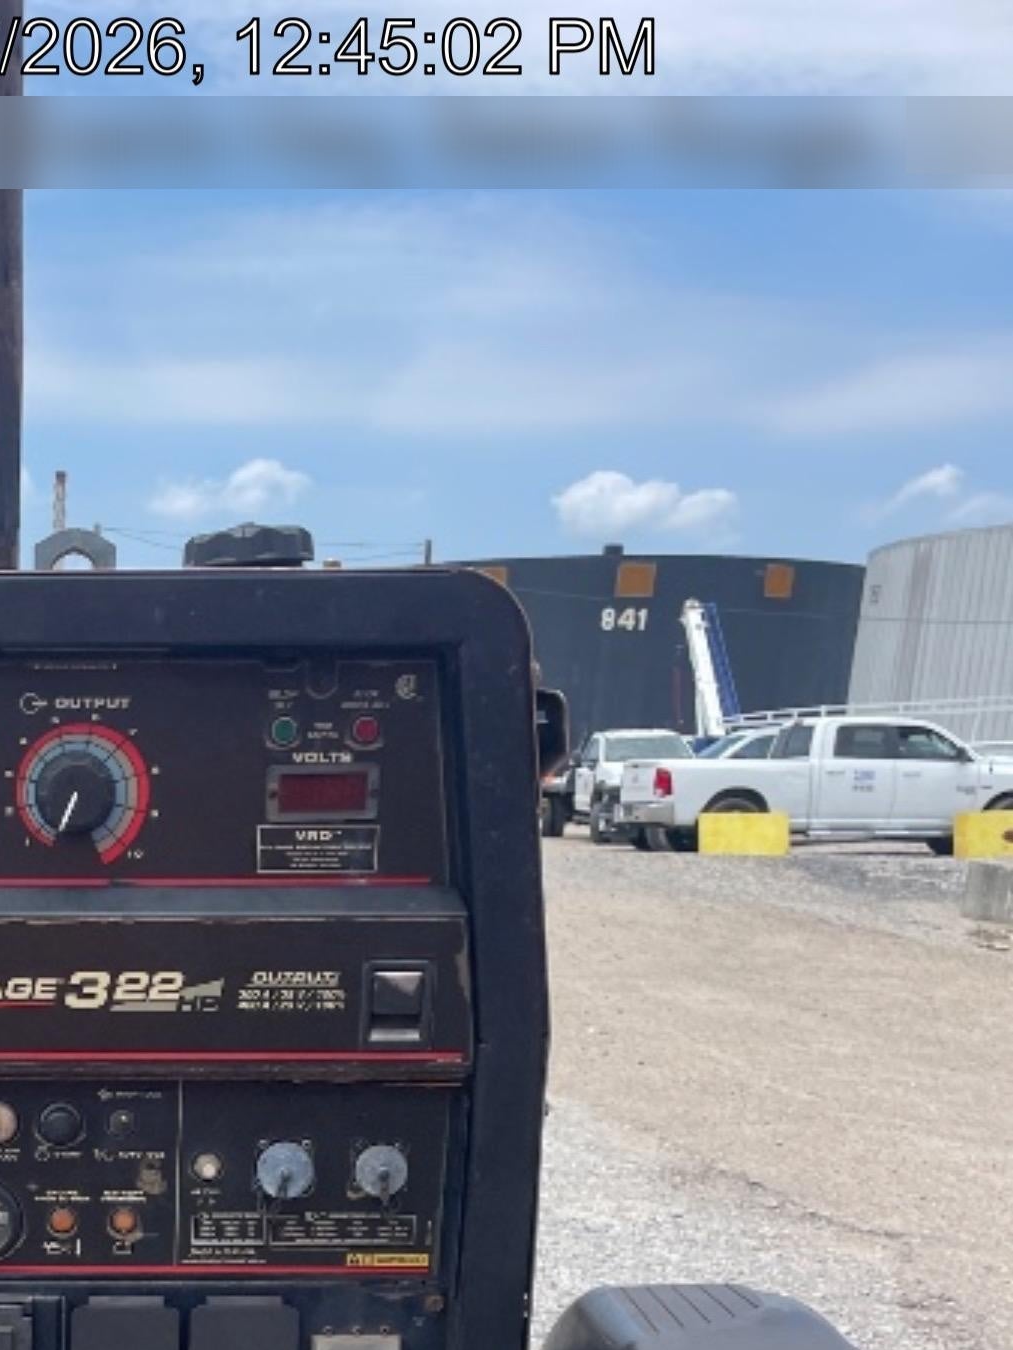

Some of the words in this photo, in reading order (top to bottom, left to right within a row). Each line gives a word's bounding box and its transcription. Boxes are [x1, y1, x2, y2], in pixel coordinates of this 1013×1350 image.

[601, 608, 648, 631] 841
[55, 698, 130, 709] OUTPUT
[293, 752, 352, 764] VOLTS
[65, 970, 183, 1009] 322
